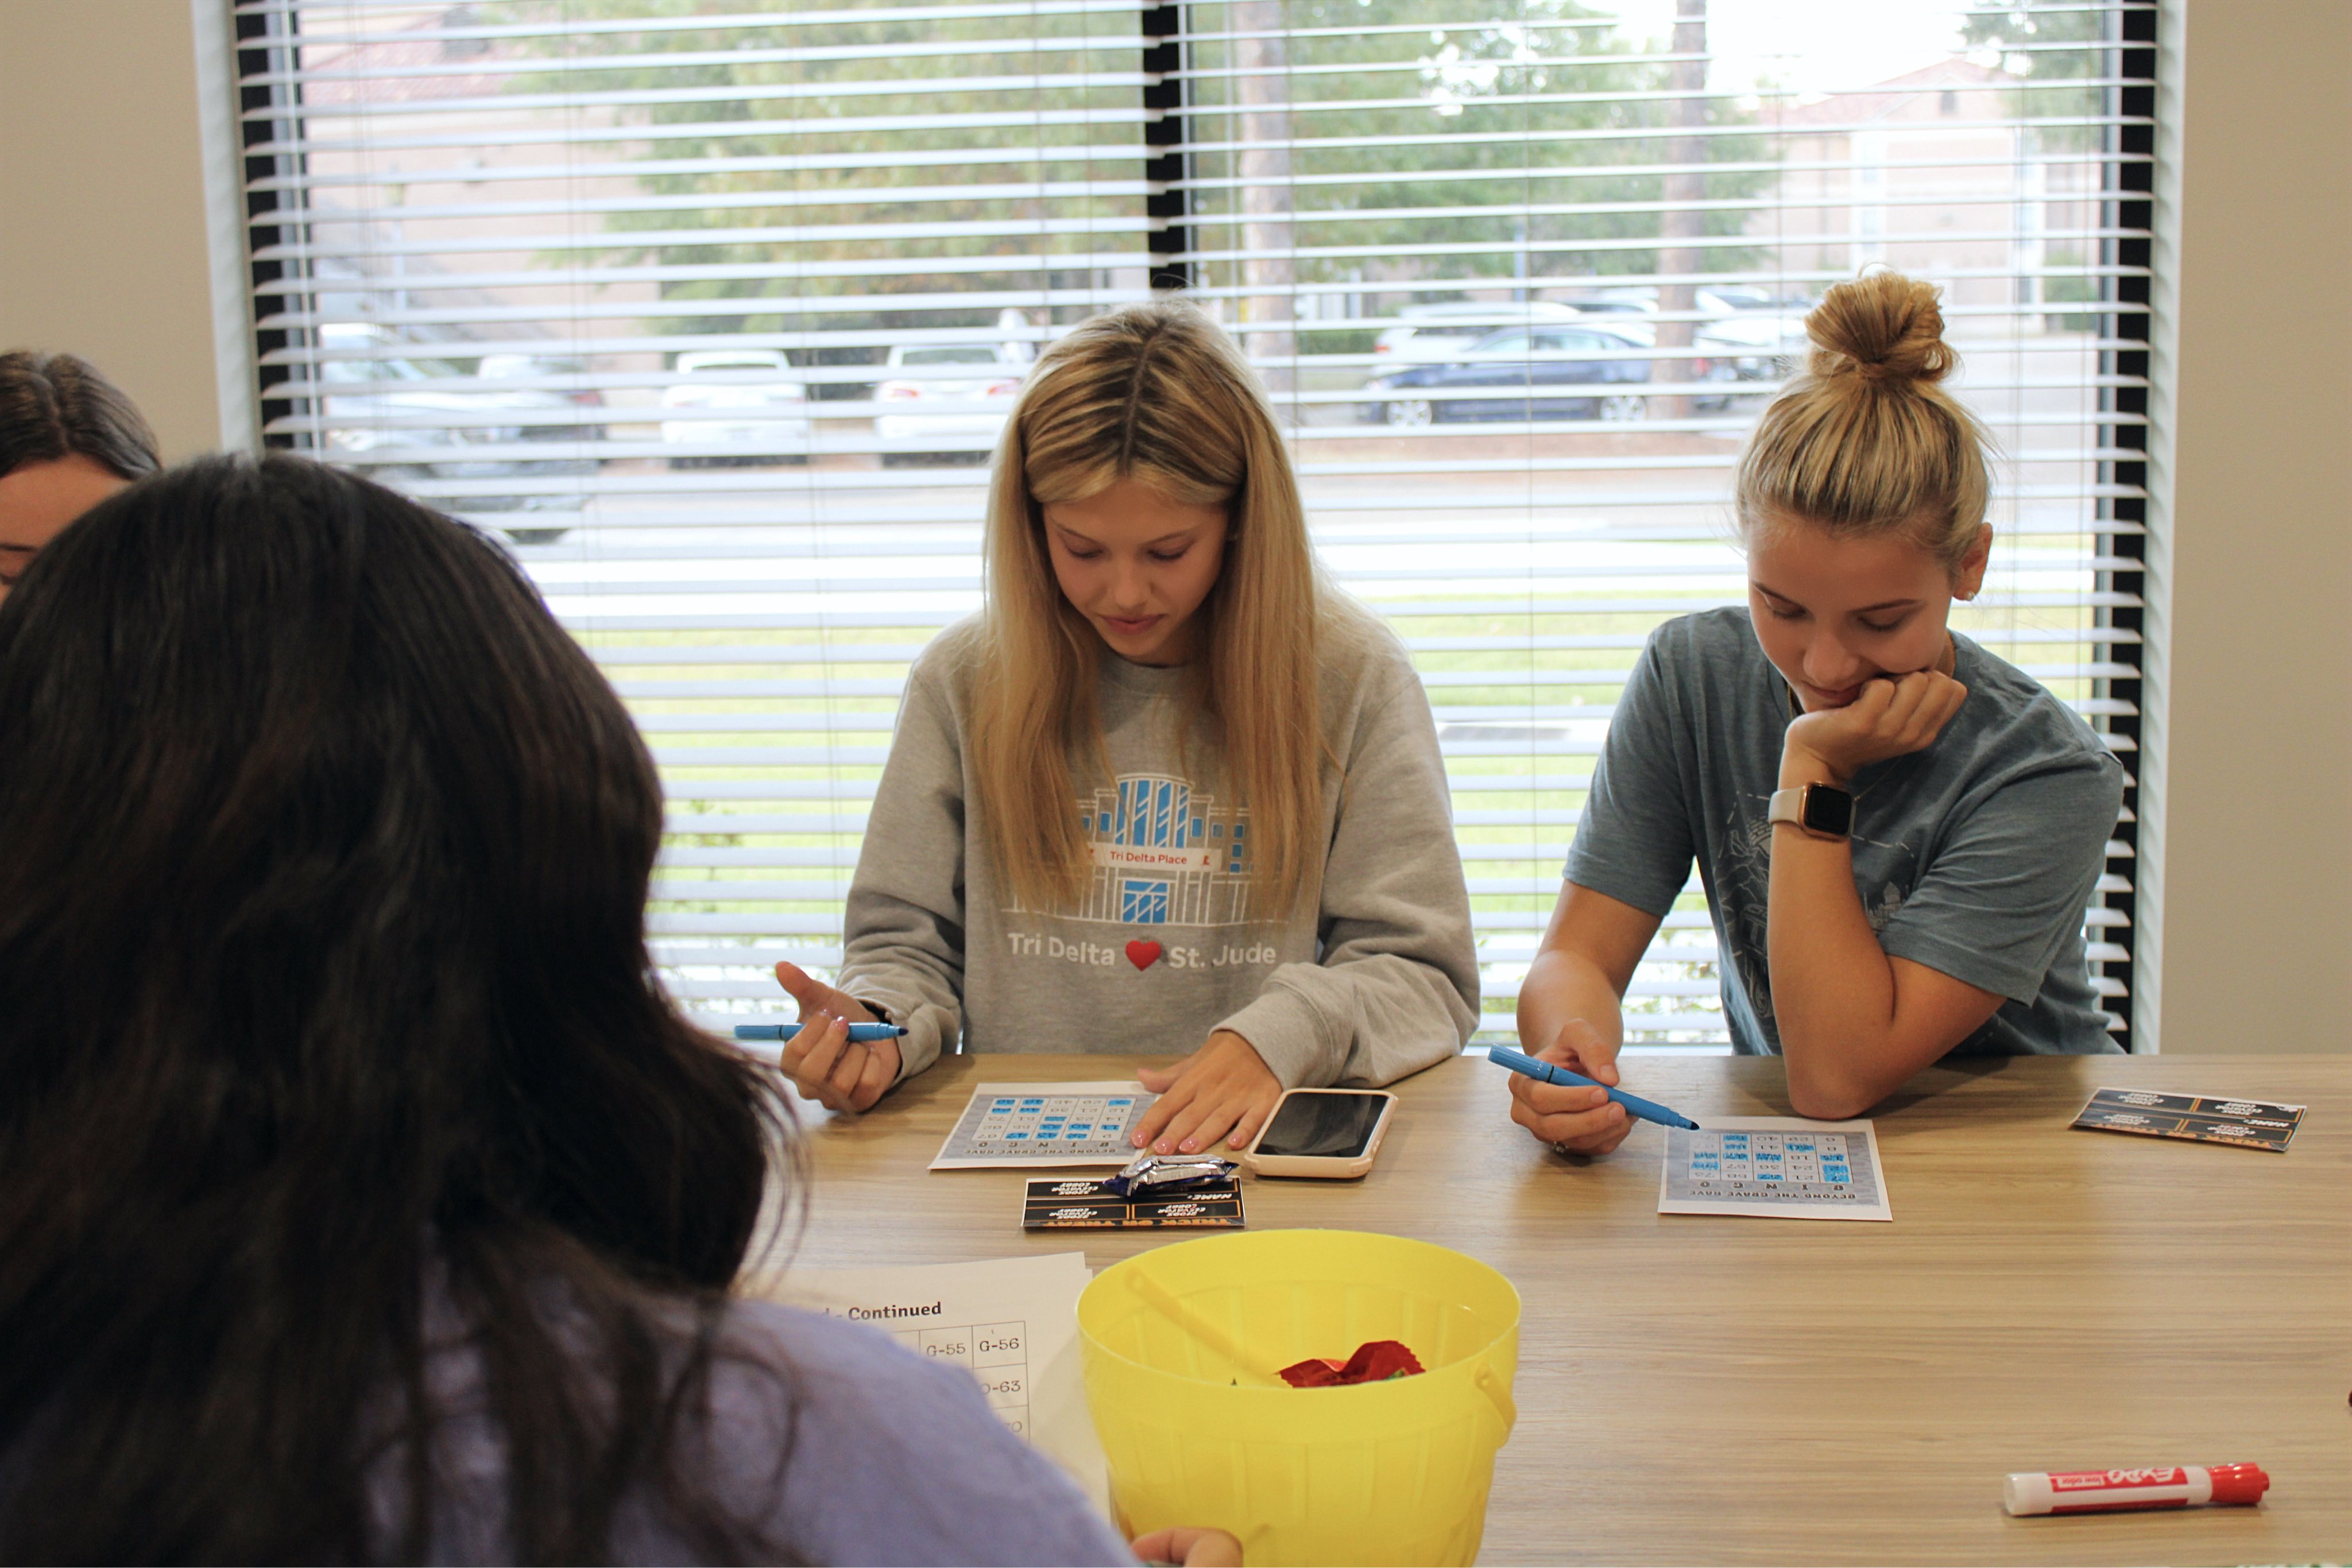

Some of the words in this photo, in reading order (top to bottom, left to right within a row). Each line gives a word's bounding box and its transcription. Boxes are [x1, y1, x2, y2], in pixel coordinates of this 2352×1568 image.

[1111, 851, 1123, 861] Tri
[1127, 853, 1155, 862] Delta
[1158, 854, 1187, 864] Place
[1008, 932, 1041, 955] Tri
[1049, 937, 1115, 966] Delta
[1169, 946, 1205, 969] St.
[1212, 942, 1276, 967] Jude
[848, 1301, 941, 1321] Continued
[926, 1342, 966, 1357] G-55
[980, 1338, 1019, 1352] G-56
